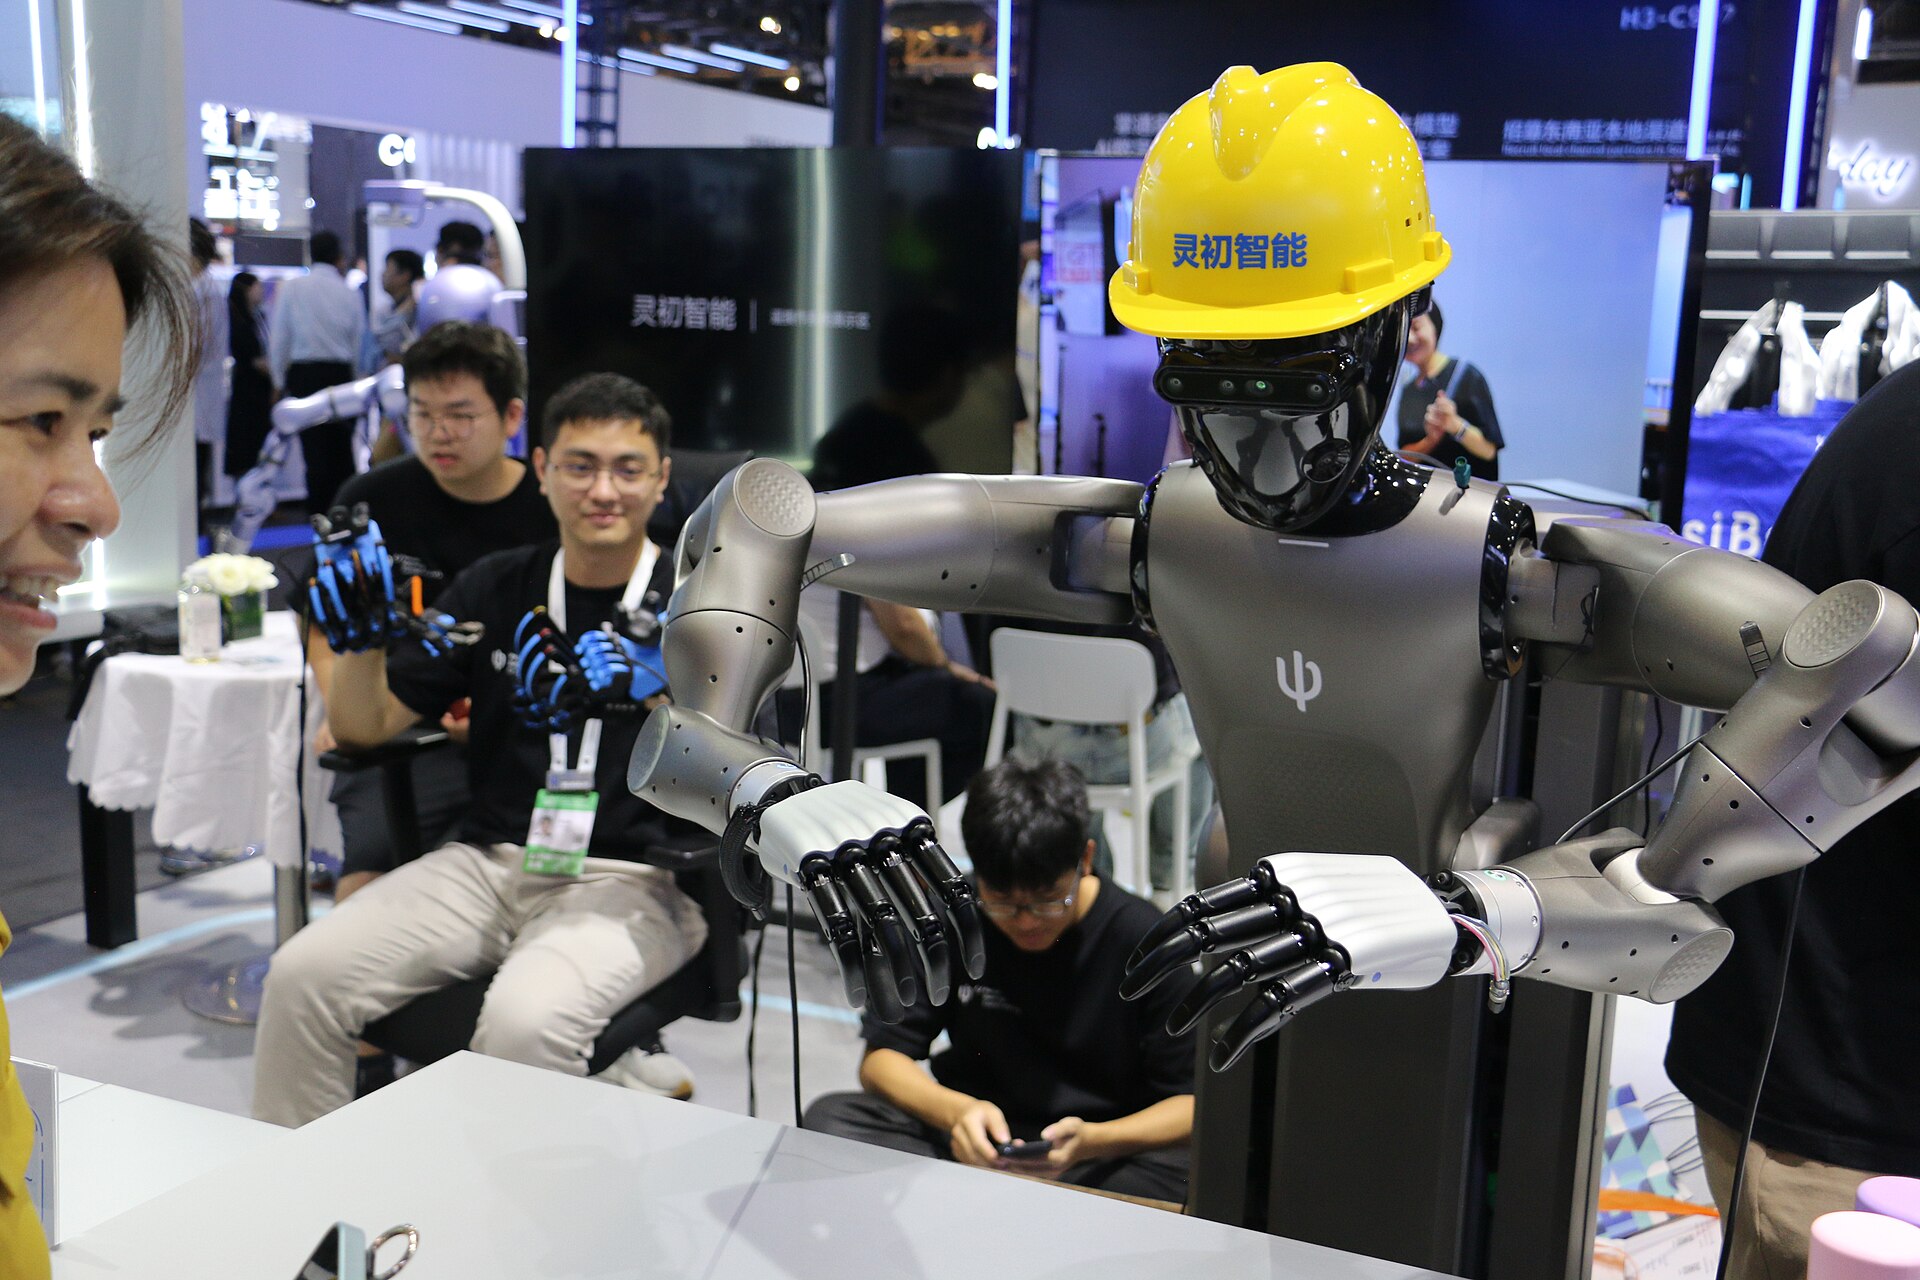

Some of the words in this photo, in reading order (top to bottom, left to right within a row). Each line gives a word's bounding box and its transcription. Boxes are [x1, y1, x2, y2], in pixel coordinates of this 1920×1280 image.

[1172, 232, 1308, 269] 灵初智能
[630, 294, 738, 331] 灵初智能
[1682, 511, 1772, 557] siB
